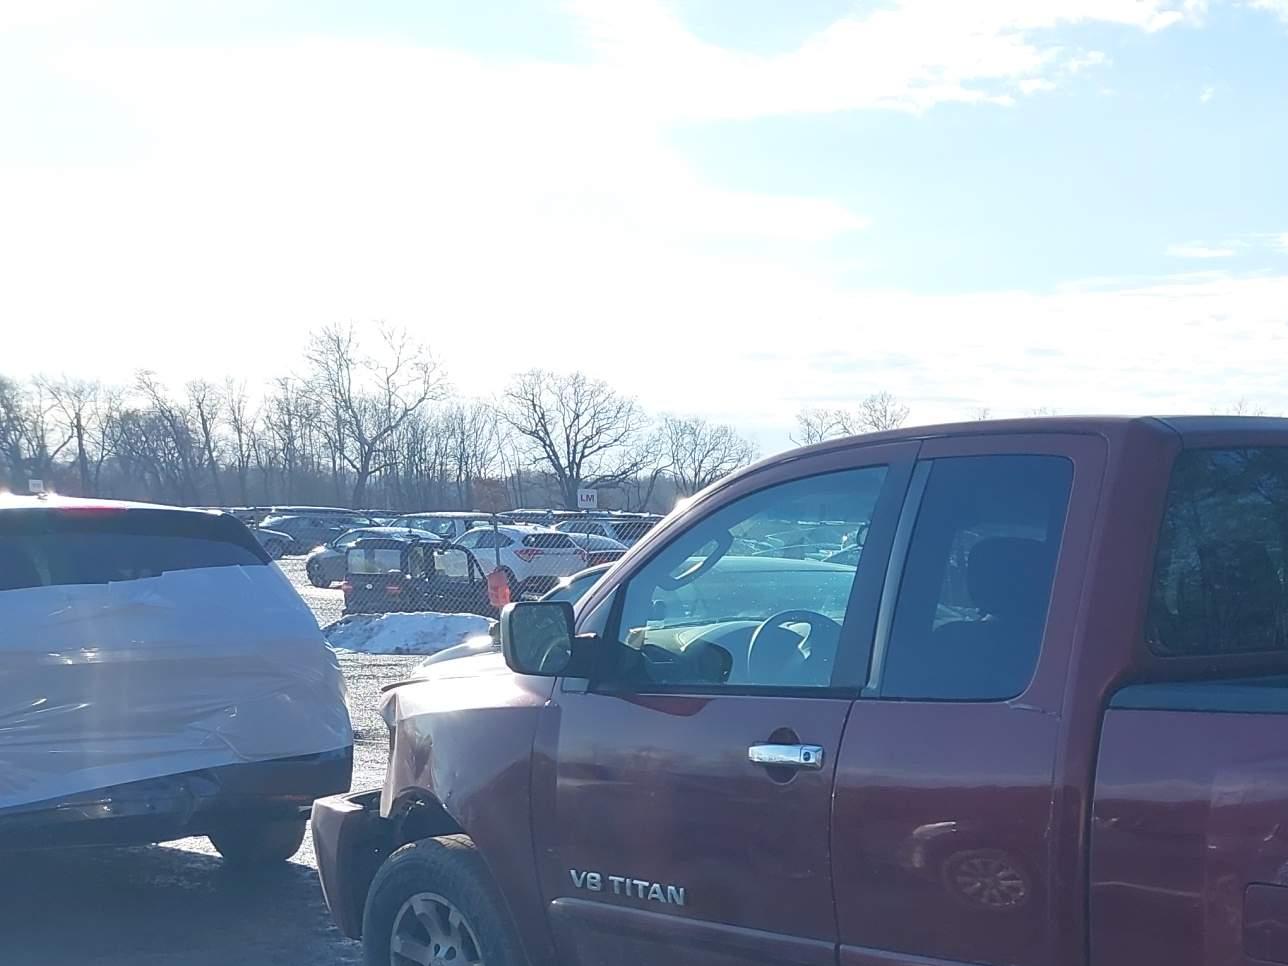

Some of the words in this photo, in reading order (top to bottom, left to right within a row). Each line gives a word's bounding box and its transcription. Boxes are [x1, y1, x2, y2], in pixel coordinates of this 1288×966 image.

[580, 494, 595, 502] LM
[569, 869, 602, 891] V8
[608, 876, 685, 905] TITAN
